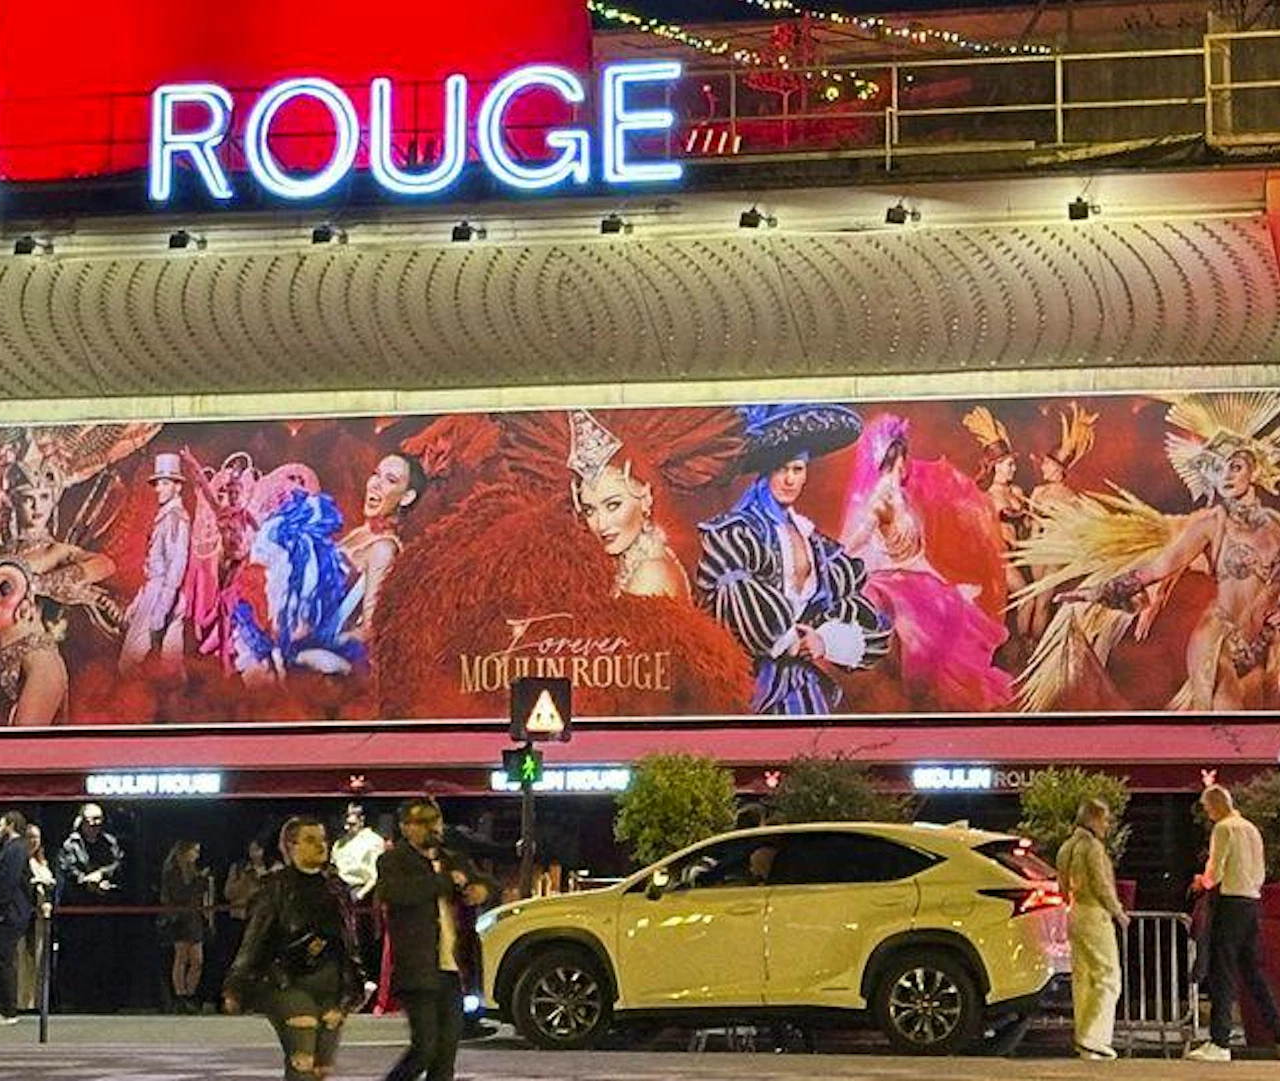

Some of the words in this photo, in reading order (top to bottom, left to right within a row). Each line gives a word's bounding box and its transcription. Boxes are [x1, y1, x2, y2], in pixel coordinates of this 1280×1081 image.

[148, 60, 683, 200] ROUGE
[506, 612, 631, 656] Forever
[571, 651, 671, 691] ROUGE
[86, 774, 157, 794] MOULIN
[913, 768, 991, 789] MOULIN
